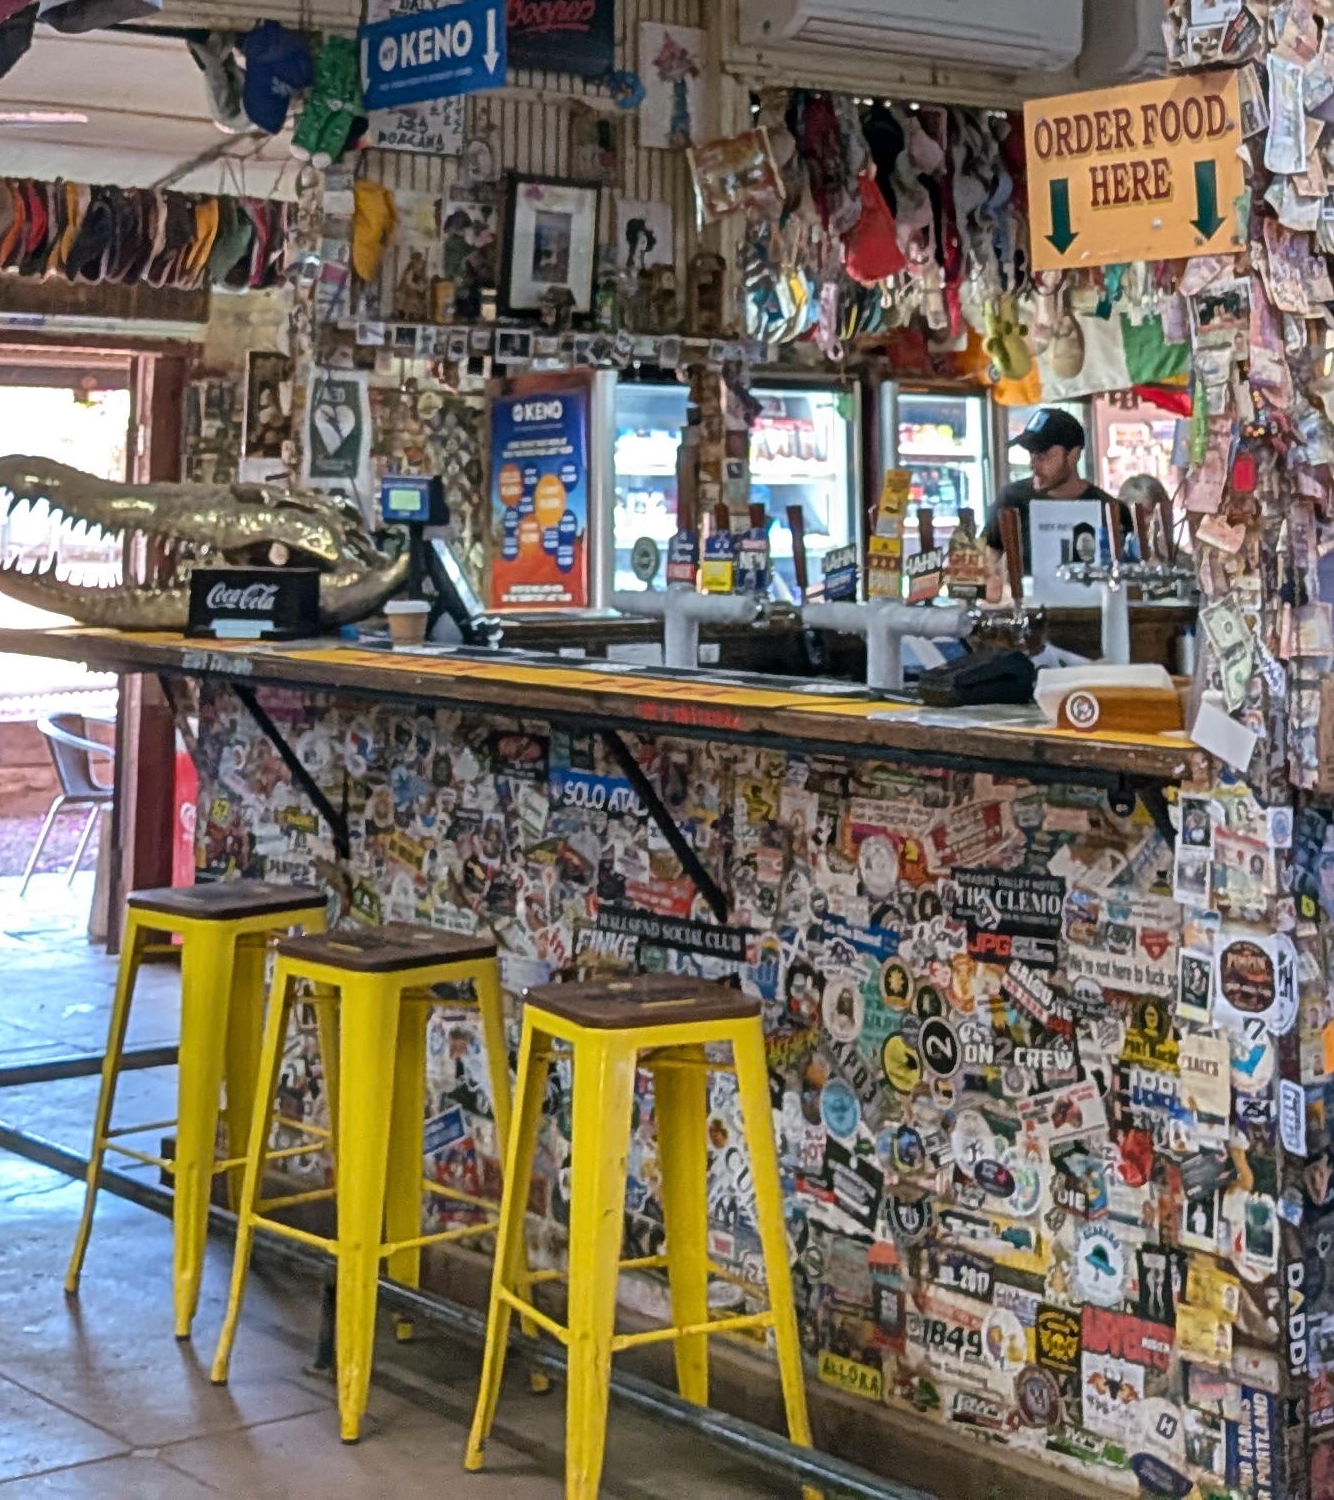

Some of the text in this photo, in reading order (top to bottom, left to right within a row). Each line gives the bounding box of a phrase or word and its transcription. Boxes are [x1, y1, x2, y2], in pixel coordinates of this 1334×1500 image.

[400, 18, 473, 68] KENO
[1034, 95, 1226, 160] ORDER FOOD
[1090, 157, 1172, 207] HERE
[524, 400, 563, 422] KENO
[1013, 1046, 1074, 1069] CREW
[923, 1318, 983, 1357] 1849
